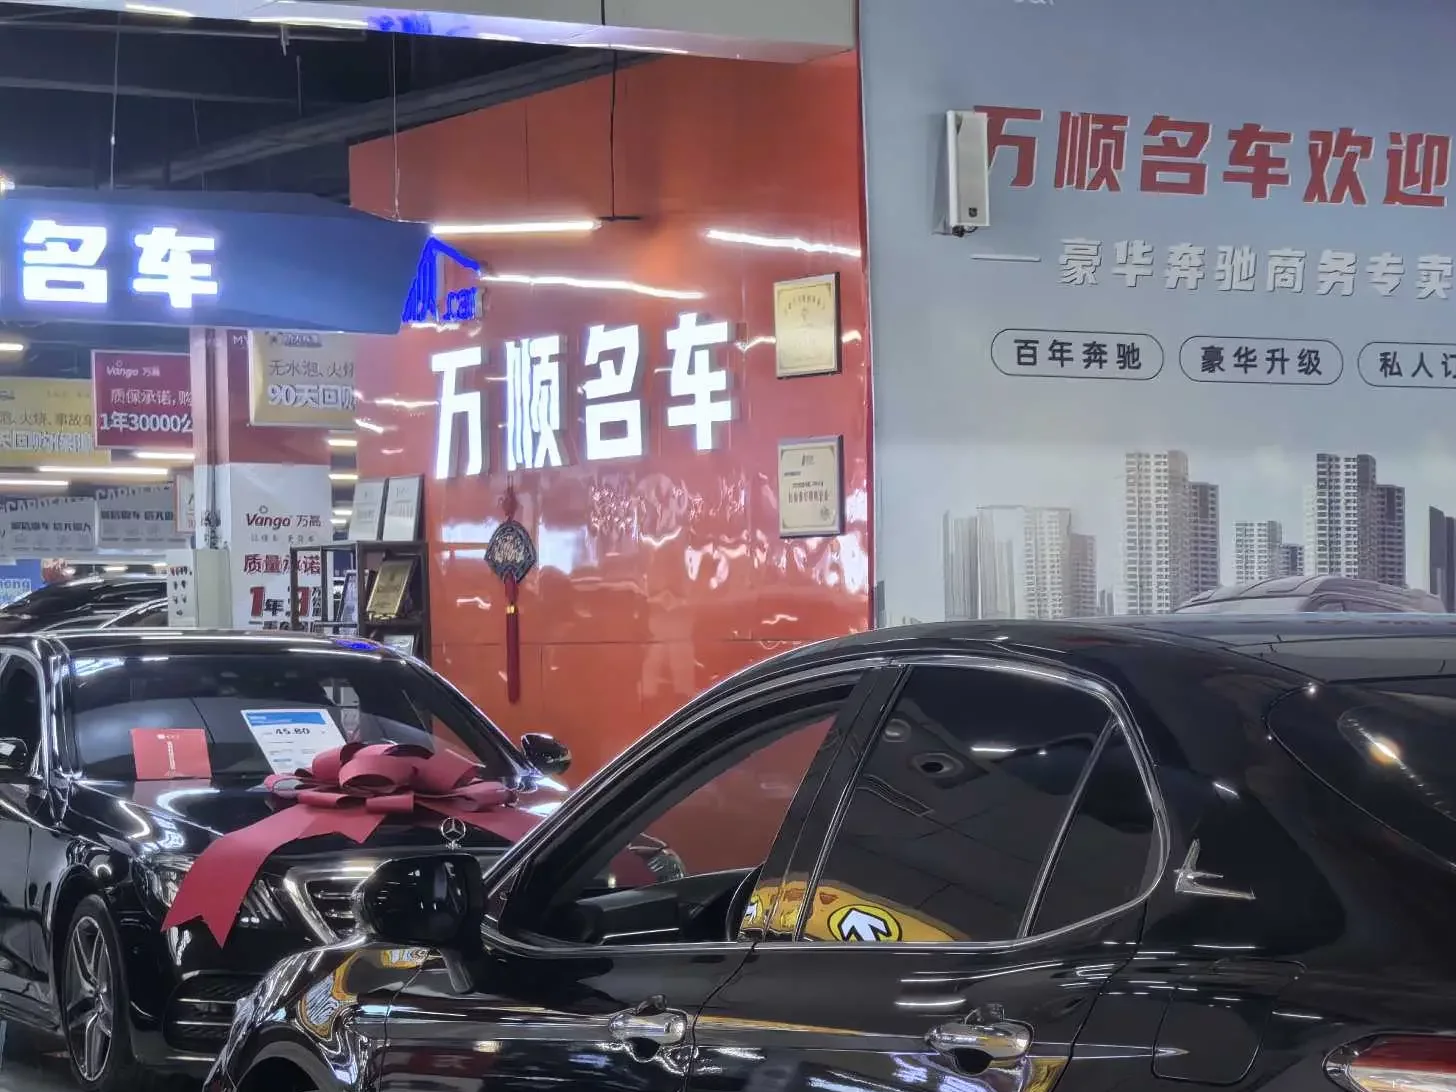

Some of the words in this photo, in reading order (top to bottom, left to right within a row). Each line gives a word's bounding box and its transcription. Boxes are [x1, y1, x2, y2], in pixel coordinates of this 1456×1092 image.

[22, 218, 219, 309] 名车
[1057, 238, 1455, 300] 豪华奔驰商务专卖
[1013, 338, 1143, 371] 百年奔驰
[1199, 344, 1324, 377] 豪华升级
[431, 312, 733, 480] 万顺名车
[245, 512, 291, 530] Vango
